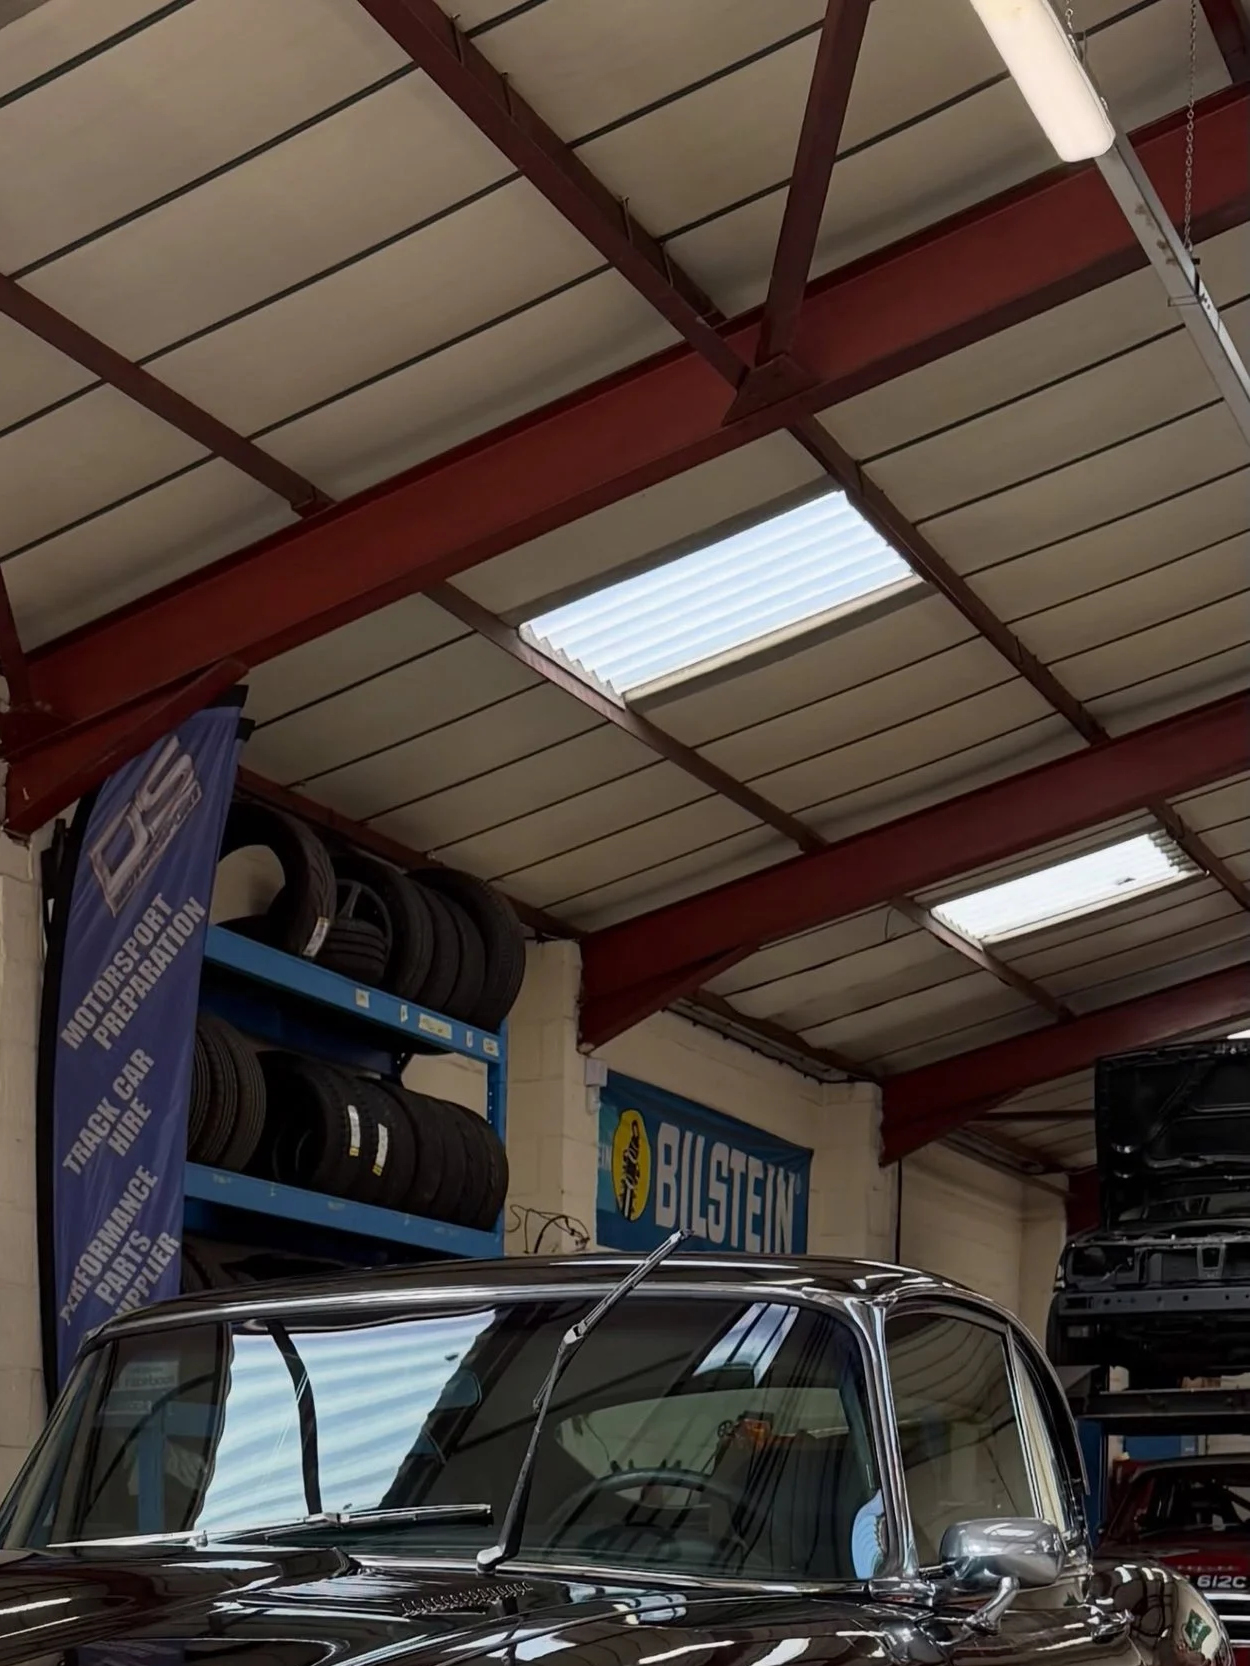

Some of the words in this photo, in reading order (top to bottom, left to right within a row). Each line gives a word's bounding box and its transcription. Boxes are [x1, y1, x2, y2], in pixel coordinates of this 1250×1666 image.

[61, 893, 173, 1050] MOTORSPORT
[93, 896, 206, 1050] PREPARATION
[62, 1097, 121, 1176] TRACK
[113, 1049, 155, 1101] CAR
[108, 1098, 152, 1157] HIRE
[59, 1165, 158, 1326] PERFORMANCE
[655, 1121, 796, 1254] BILSTEIN
[94, 1230, 152, 1306] PARTS
[115, 1232, 181, 1316] UPPLIER
[1196, 1574, 1247, 1590] 612C
